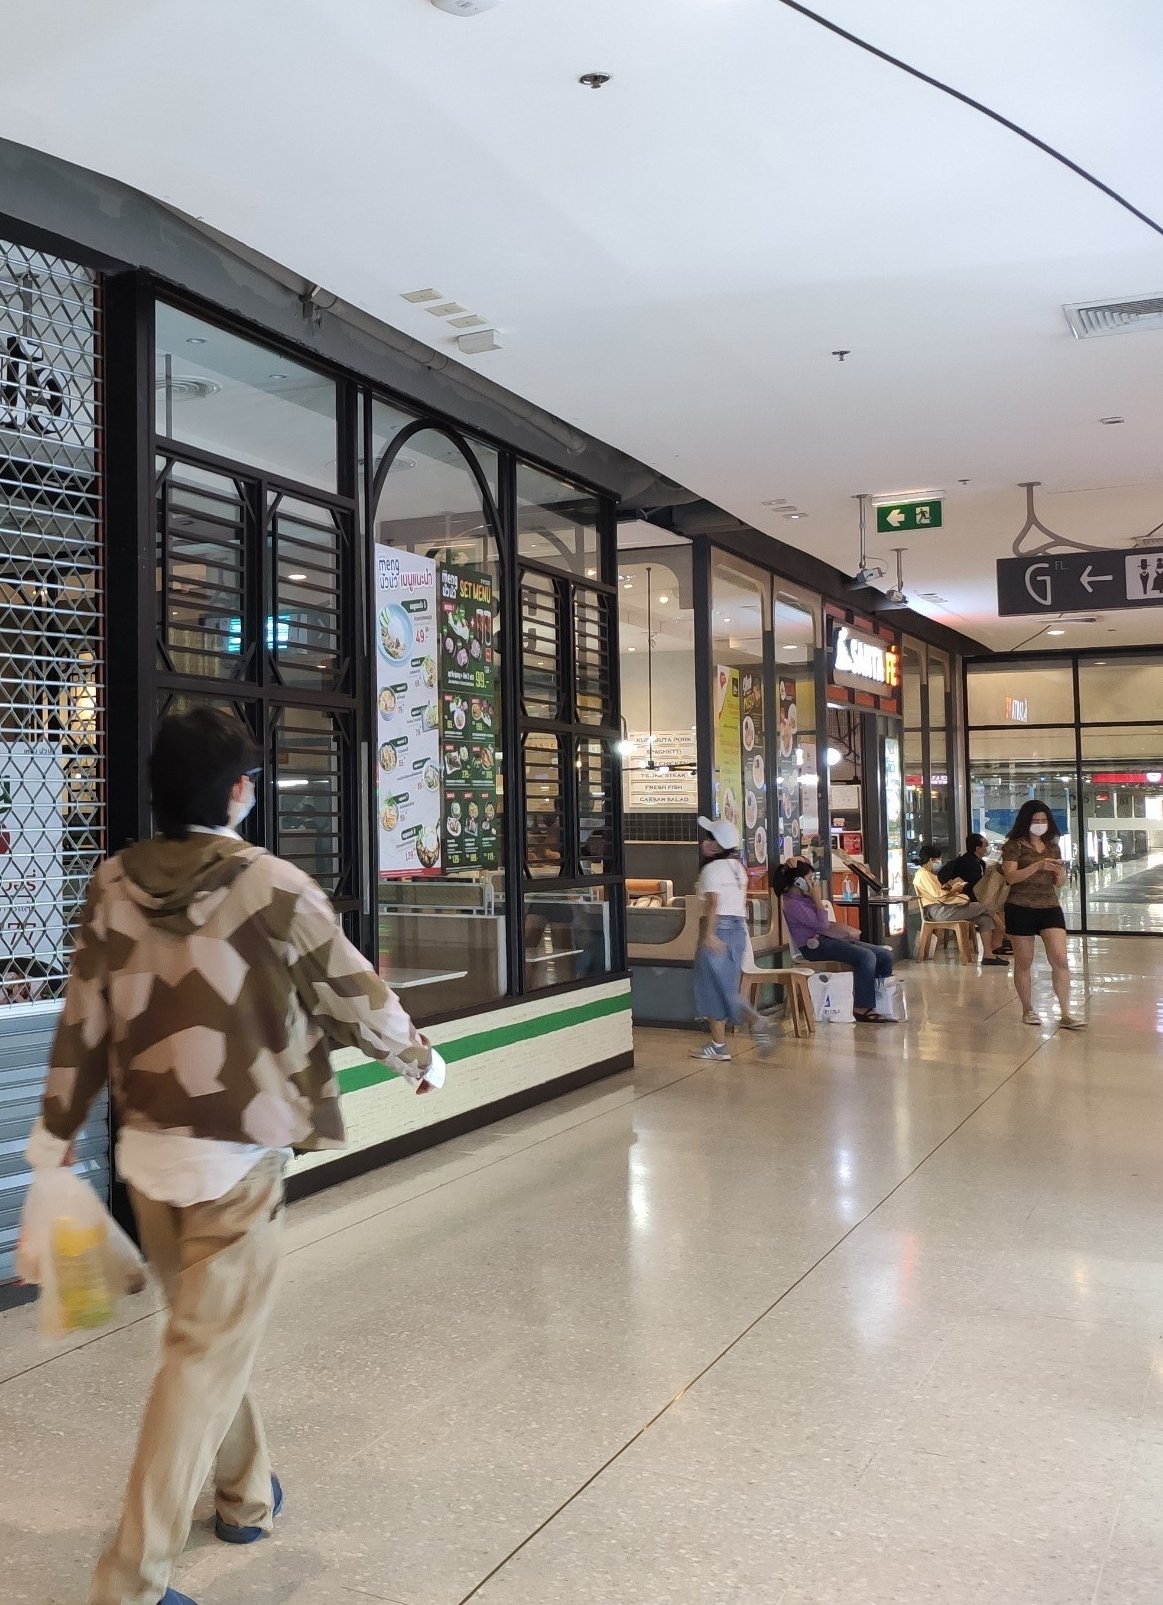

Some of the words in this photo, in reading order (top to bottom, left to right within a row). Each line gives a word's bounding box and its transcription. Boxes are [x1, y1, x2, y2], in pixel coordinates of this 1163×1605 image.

[379, 558, 400, 575] meng
[460, 579, 472, 599] SET
[473, 582, 491, 604] MENU
[1025, 563, 1052, 606] G
[1055, 561, 1069, 570] FL
